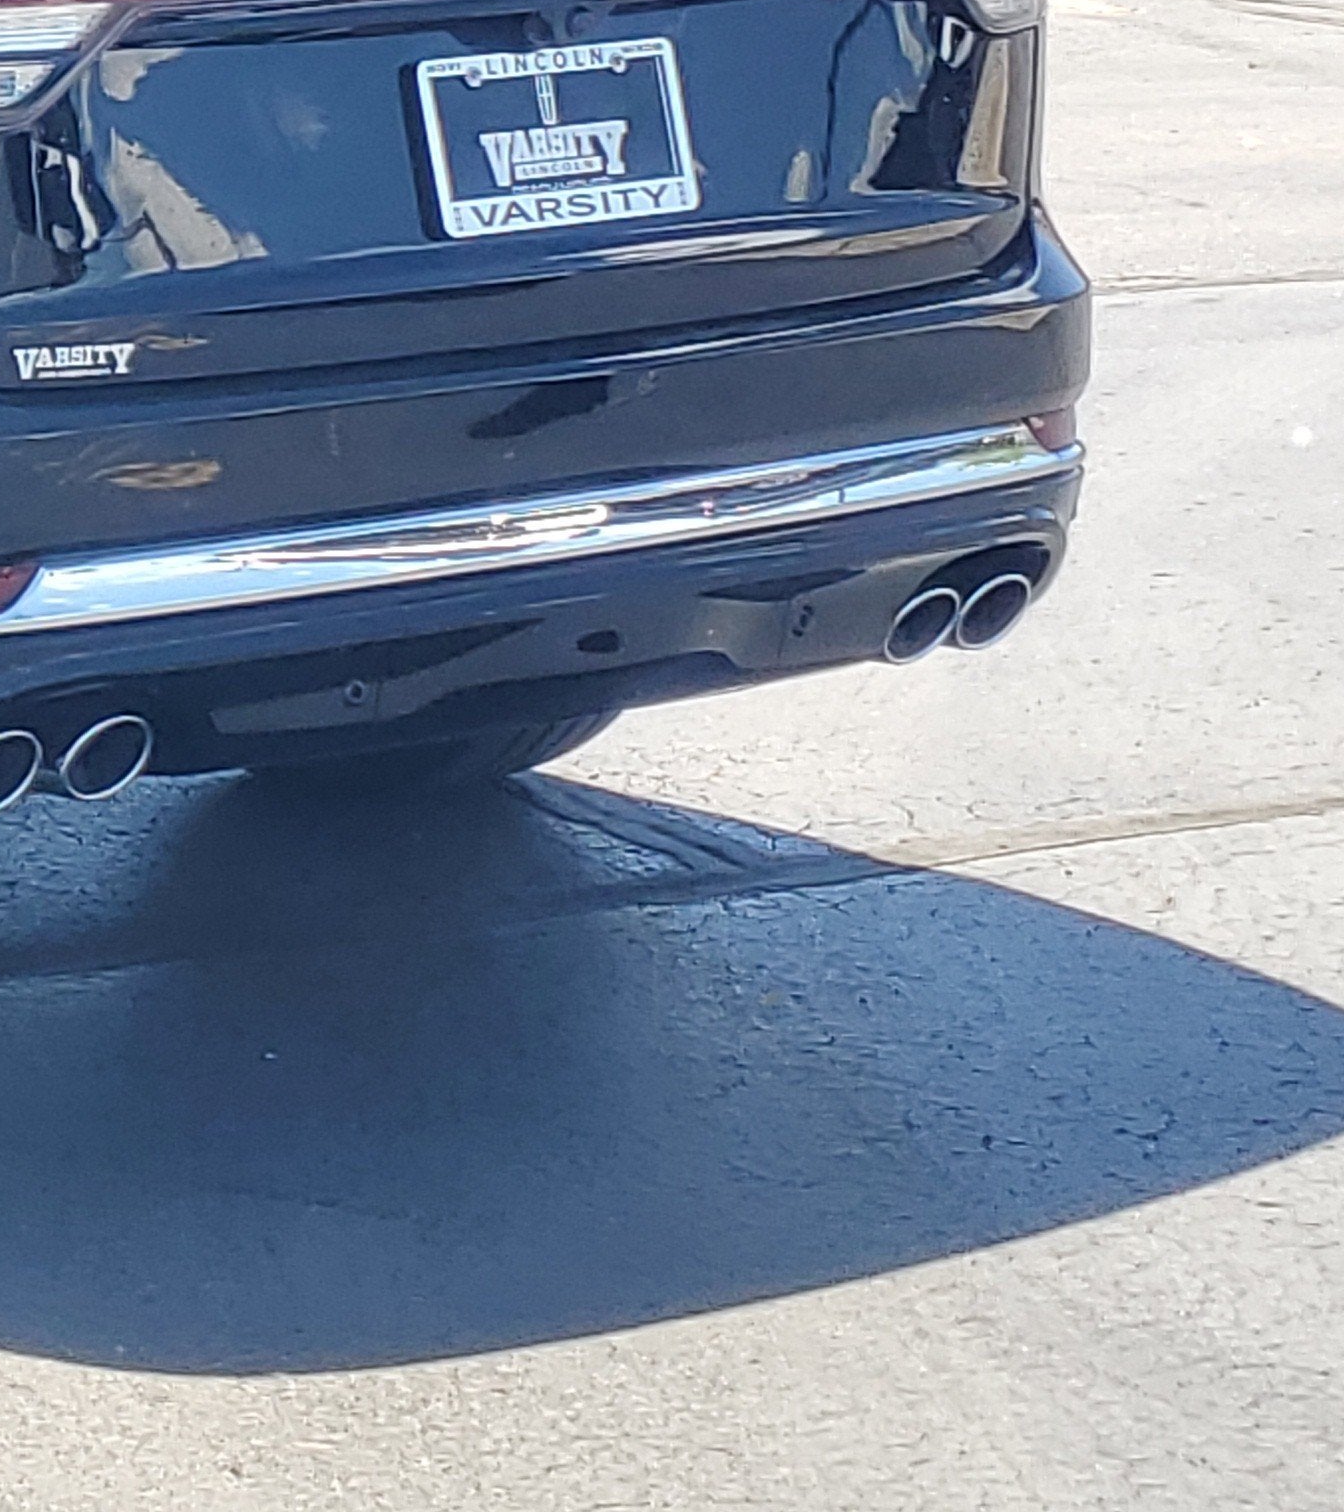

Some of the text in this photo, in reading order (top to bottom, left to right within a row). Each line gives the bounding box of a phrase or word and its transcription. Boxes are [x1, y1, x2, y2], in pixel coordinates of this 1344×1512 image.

[484, 46, 605, 76] LINCOLN
[478, 119, 628, 188] VARSITY
[521, 159, 594, 177] LINCOLN
[470, 183, 669, 228] VARSITY
[12, 342, 137, 380] VARSITY
